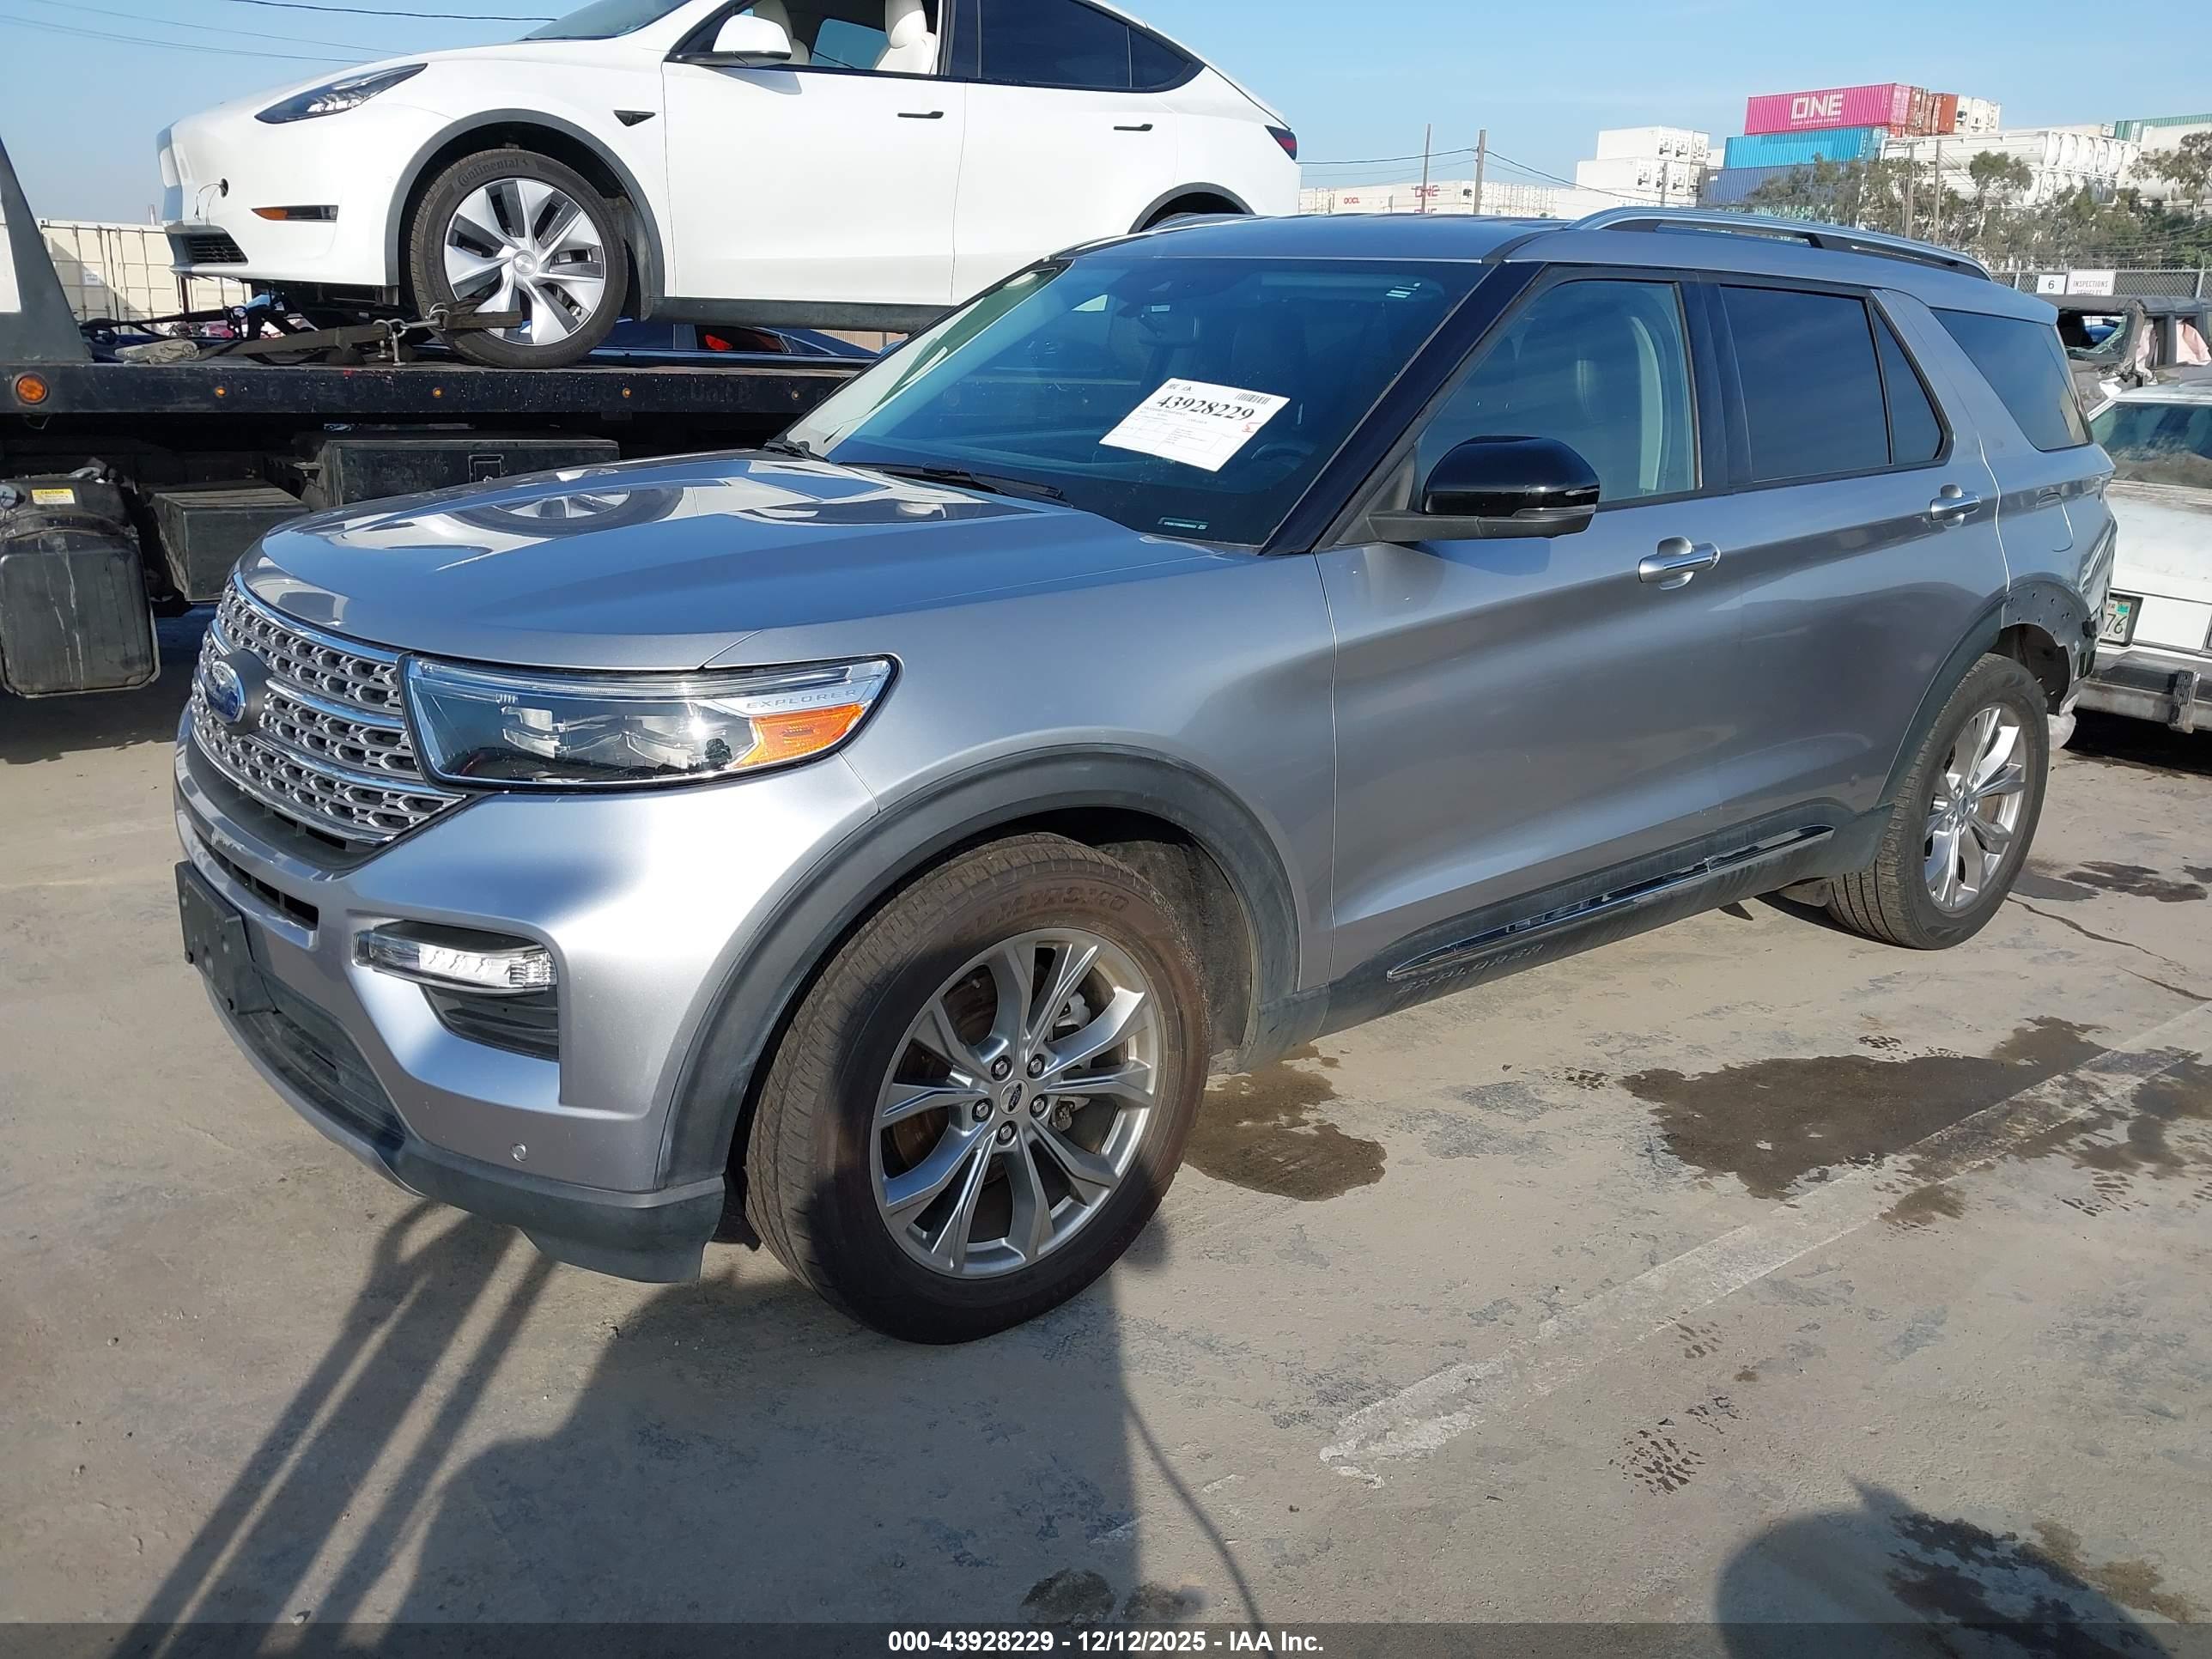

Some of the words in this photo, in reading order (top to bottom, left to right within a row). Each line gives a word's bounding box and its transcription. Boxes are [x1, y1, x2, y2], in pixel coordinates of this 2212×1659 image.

[1791, 94, 1844, 119] ONE
[2048, 280, 2055, 289] 6
[1157, 395, 1255, 421] 43928229
[746, 689, 857, 708] EXPLORER
